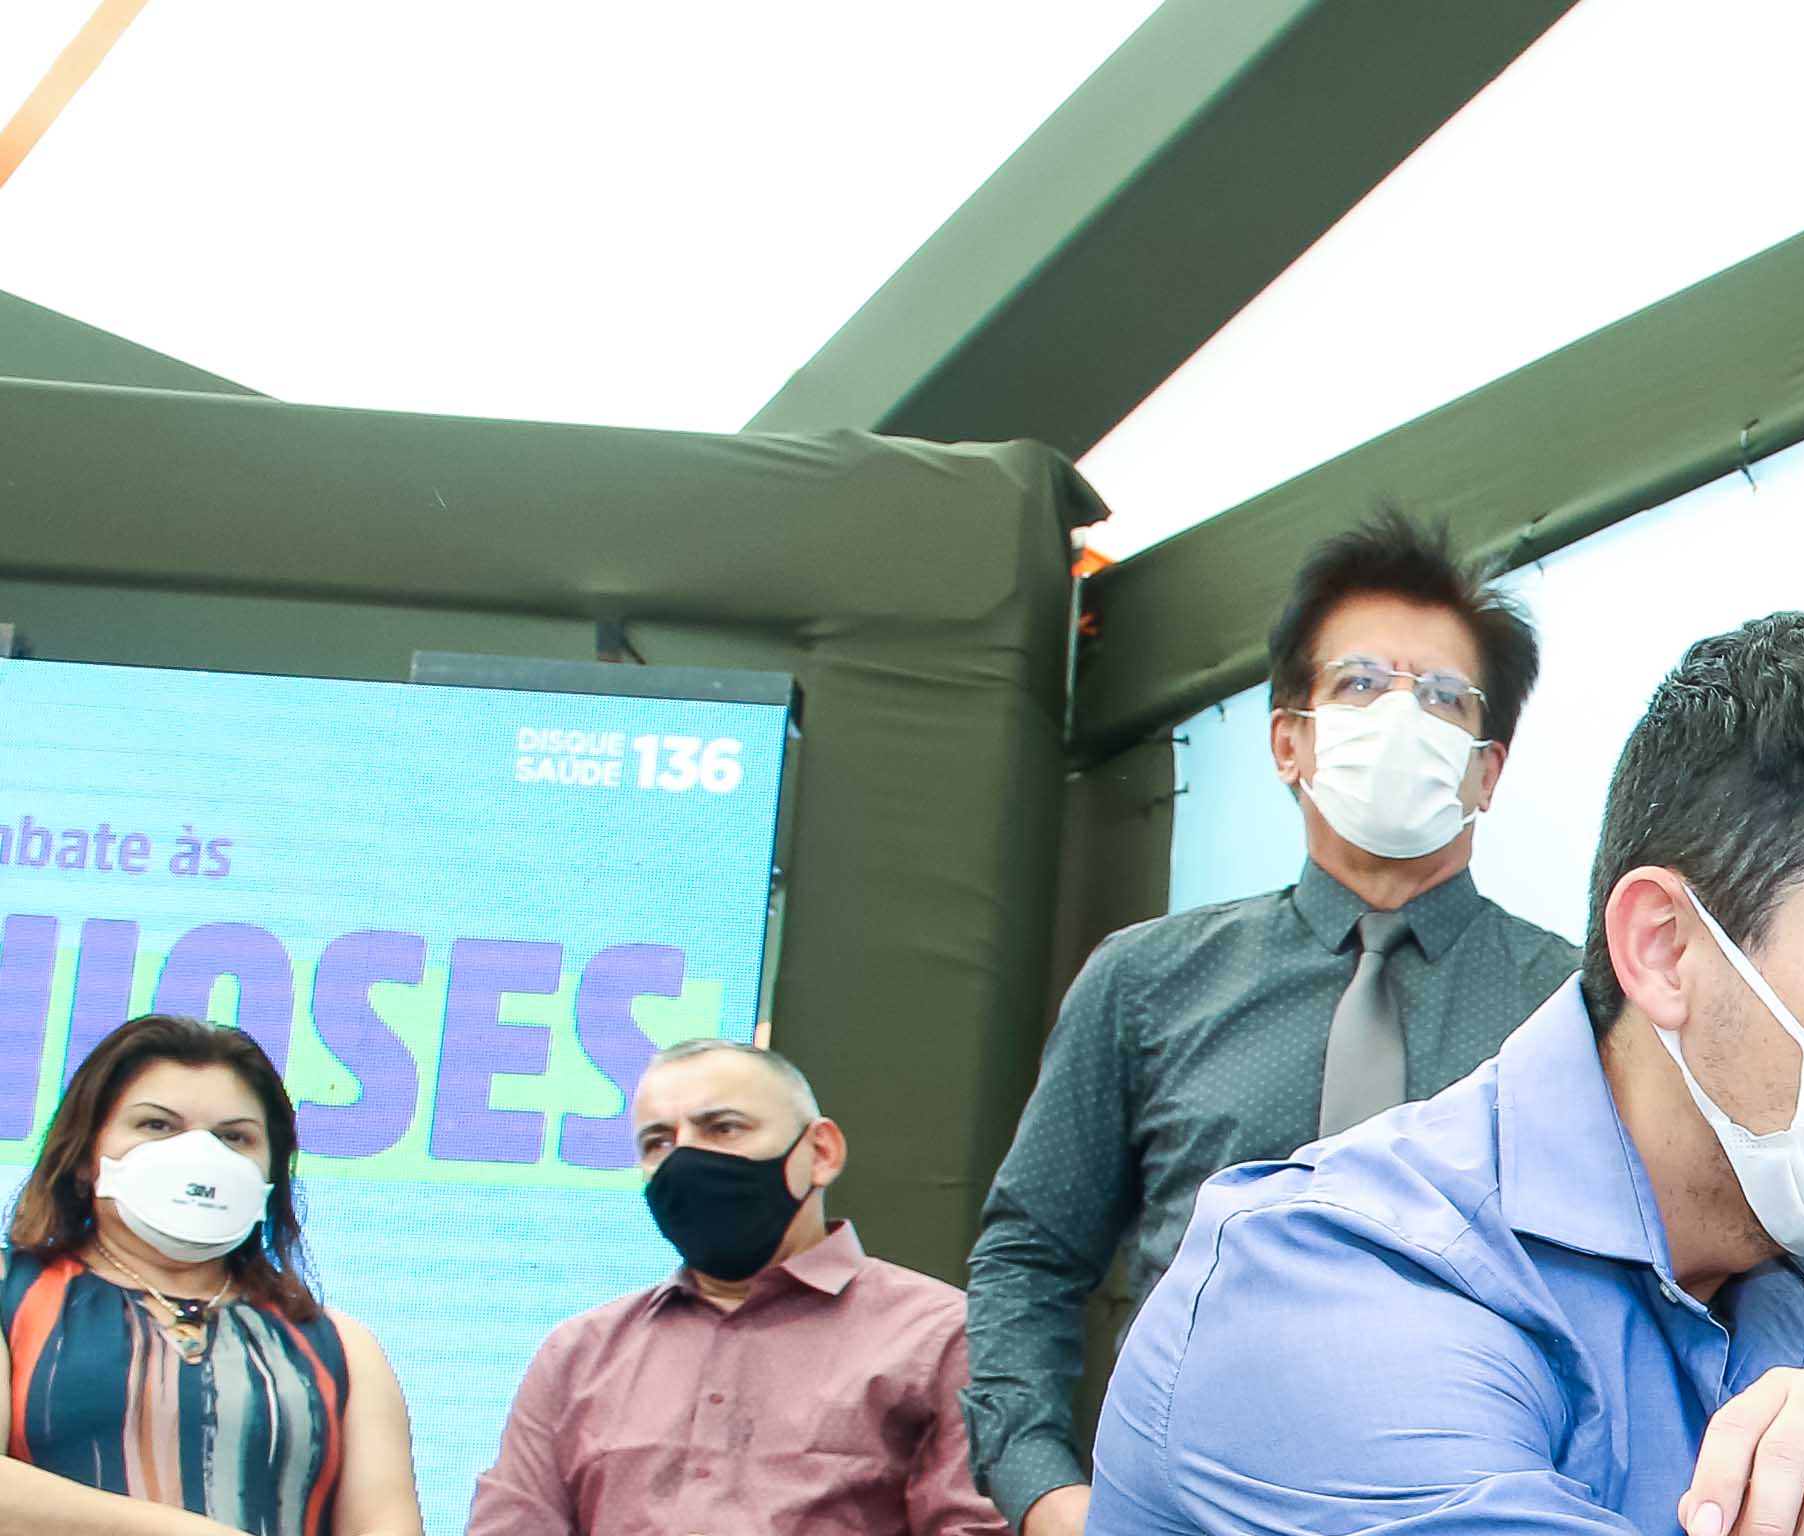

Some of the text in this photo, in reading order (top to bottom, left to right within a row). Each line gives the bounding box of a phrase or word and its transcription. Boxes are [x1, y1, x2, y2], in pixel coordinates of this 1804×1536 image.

[517, 727, 624, 756] DISQUE
[633, 734, 743, 793] 136
[169, 823, 234, 879] às
[185, 1182, 216, 1199] 3M
